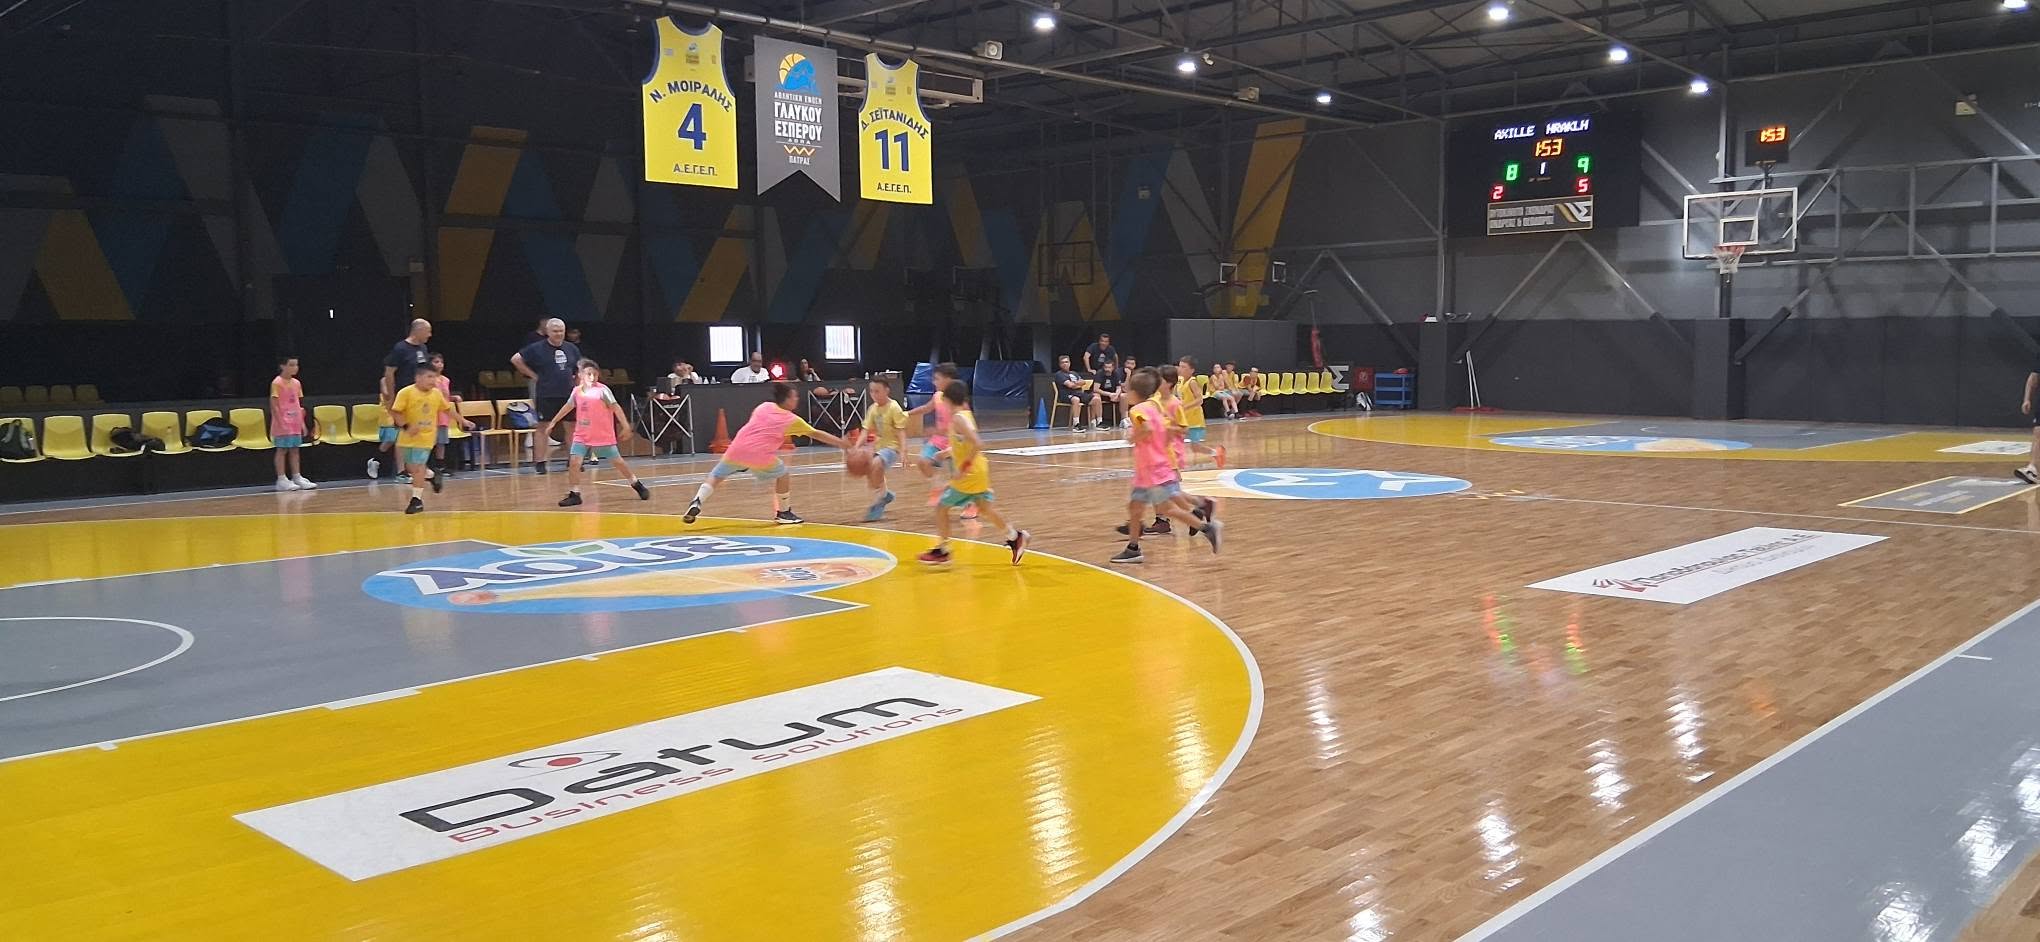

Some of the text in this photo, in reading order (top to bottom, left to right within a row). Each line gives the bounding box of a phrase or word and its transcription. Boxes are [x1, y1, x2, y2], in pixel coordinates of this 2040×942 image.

[774, 101, 822, 123] ΓΛΑΥΚΟΥ
[678, 103, 707, 150] 4
[775, 120, 822, 141] ΕΣΠΕΡΟΥ
[1494, 125, 1536, 140] AXILLE
[875, 129, 909, 171] 11
[1535, 138, 1563, 157] 1:53
[1506, 164, 1518, 181] 8
[1540, 162, 1546, 175] 1
[1577, 157, 1589, 173] 9
[1493, 185, 1503, 199] 2
[1578, 178, 1589, 193] 5
[399, 698, 939, 832] Datum
[448, 767, 734, 842] Business
